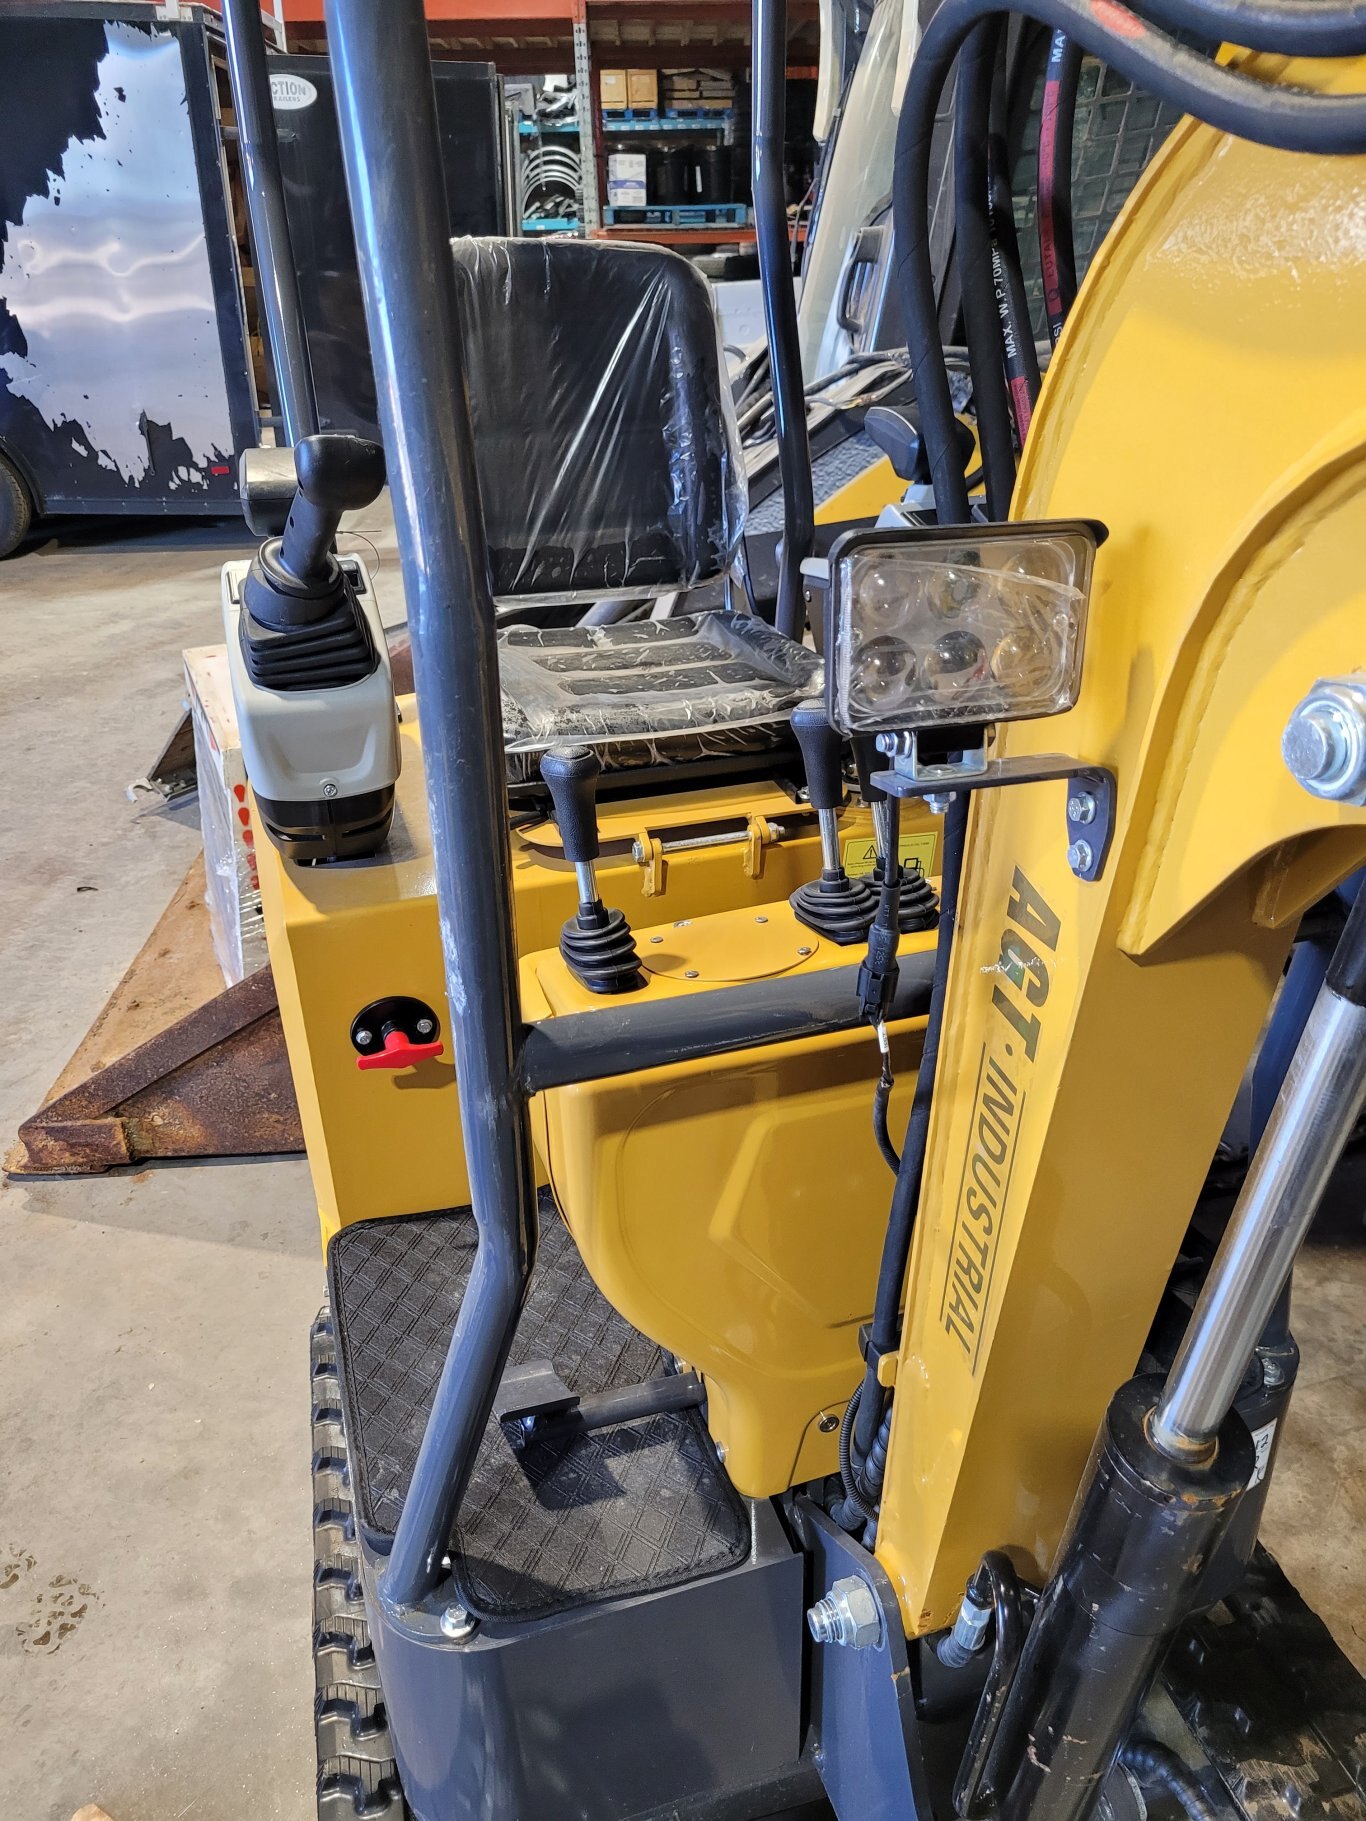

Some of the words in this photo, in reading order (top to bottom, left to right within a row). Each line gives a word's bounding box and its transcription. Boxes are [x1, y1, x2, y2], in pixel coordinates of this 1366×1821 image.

[271, 80, 306, 96] CTION
[1052, 322, 1063, 344] SI
[991, 864, 1062, 1064] AGT
[944, 1055, 1018, 1355] INDUSTRIAL
